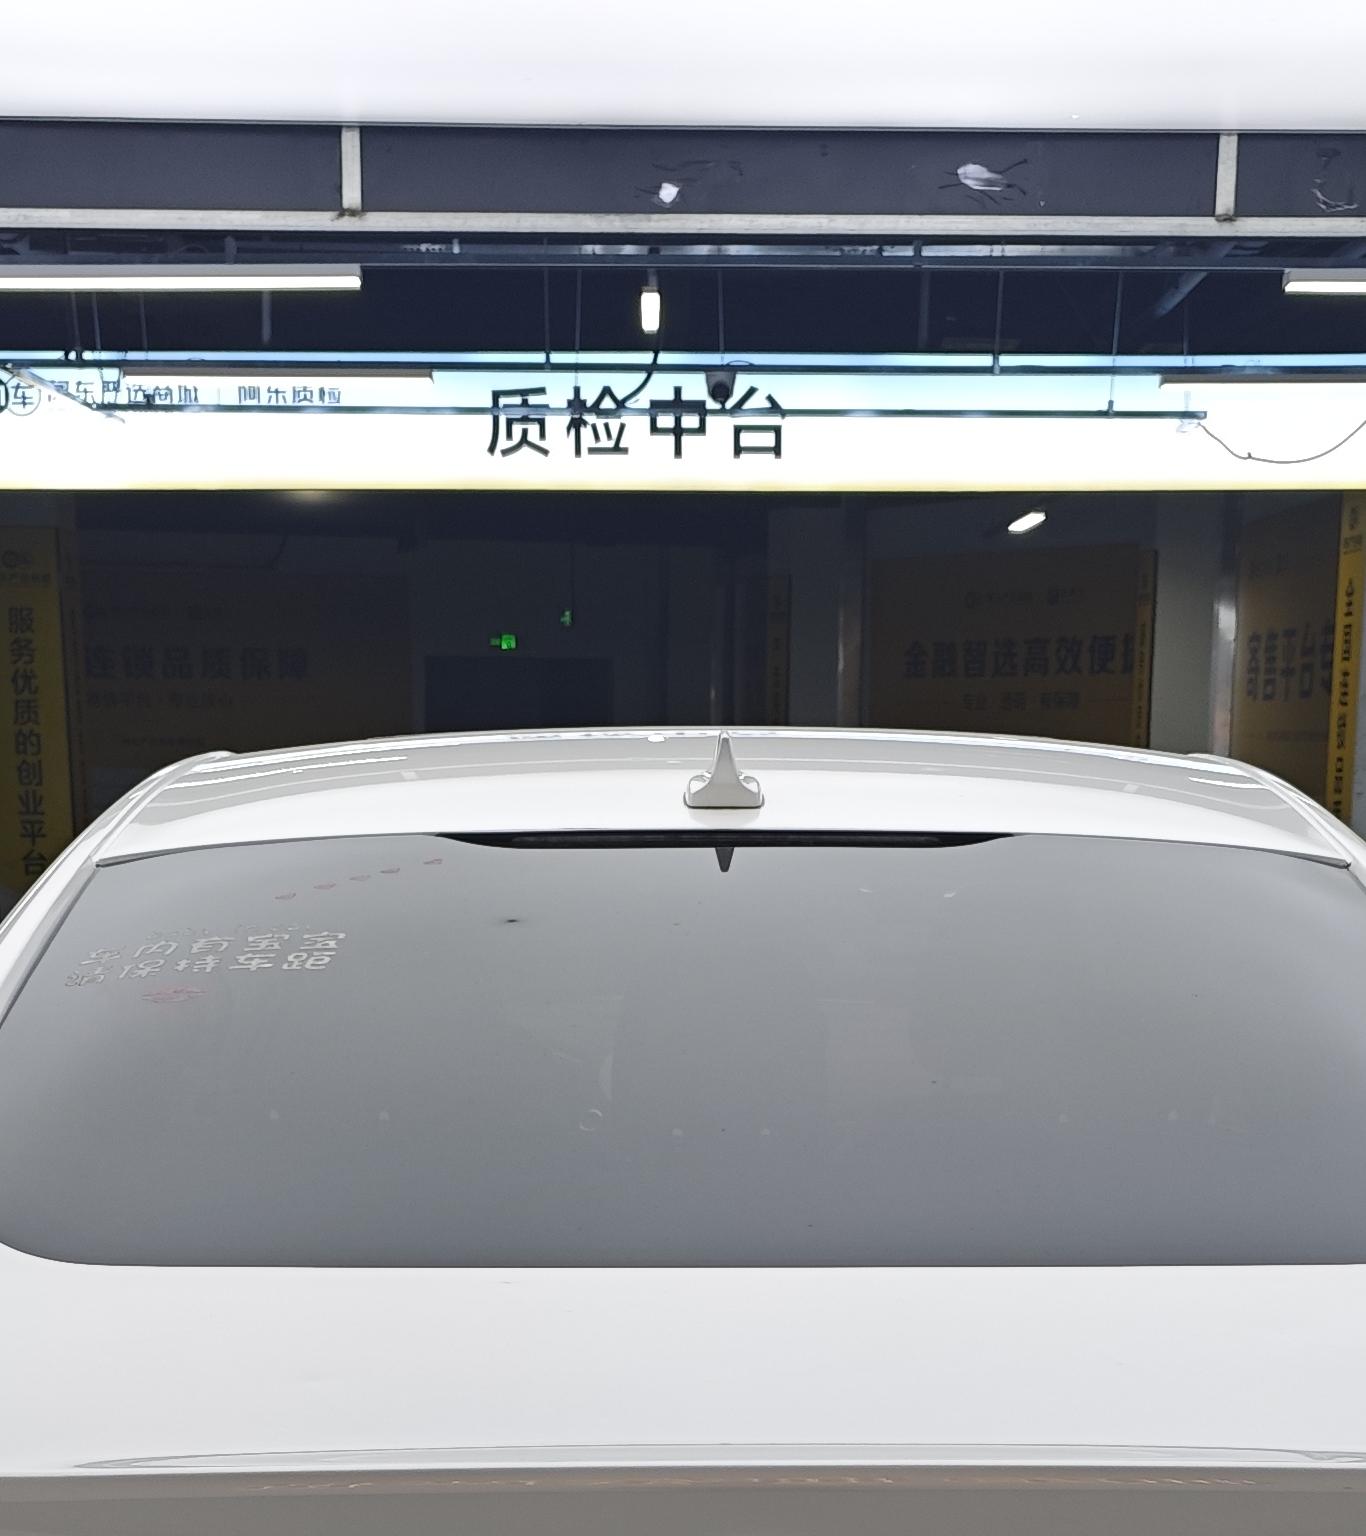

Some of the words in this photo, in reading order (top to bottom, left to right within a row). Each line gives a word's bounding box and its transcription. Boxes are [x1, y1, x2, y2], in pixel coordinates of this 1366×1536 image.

[487, 384, 786, 460] 质检中台
[7, 606, 48, 877] 服务优质的创业平台
[64, 951, 337, 987] 请保持车距
[78, 931, 346, 966] 车内有宝宝
